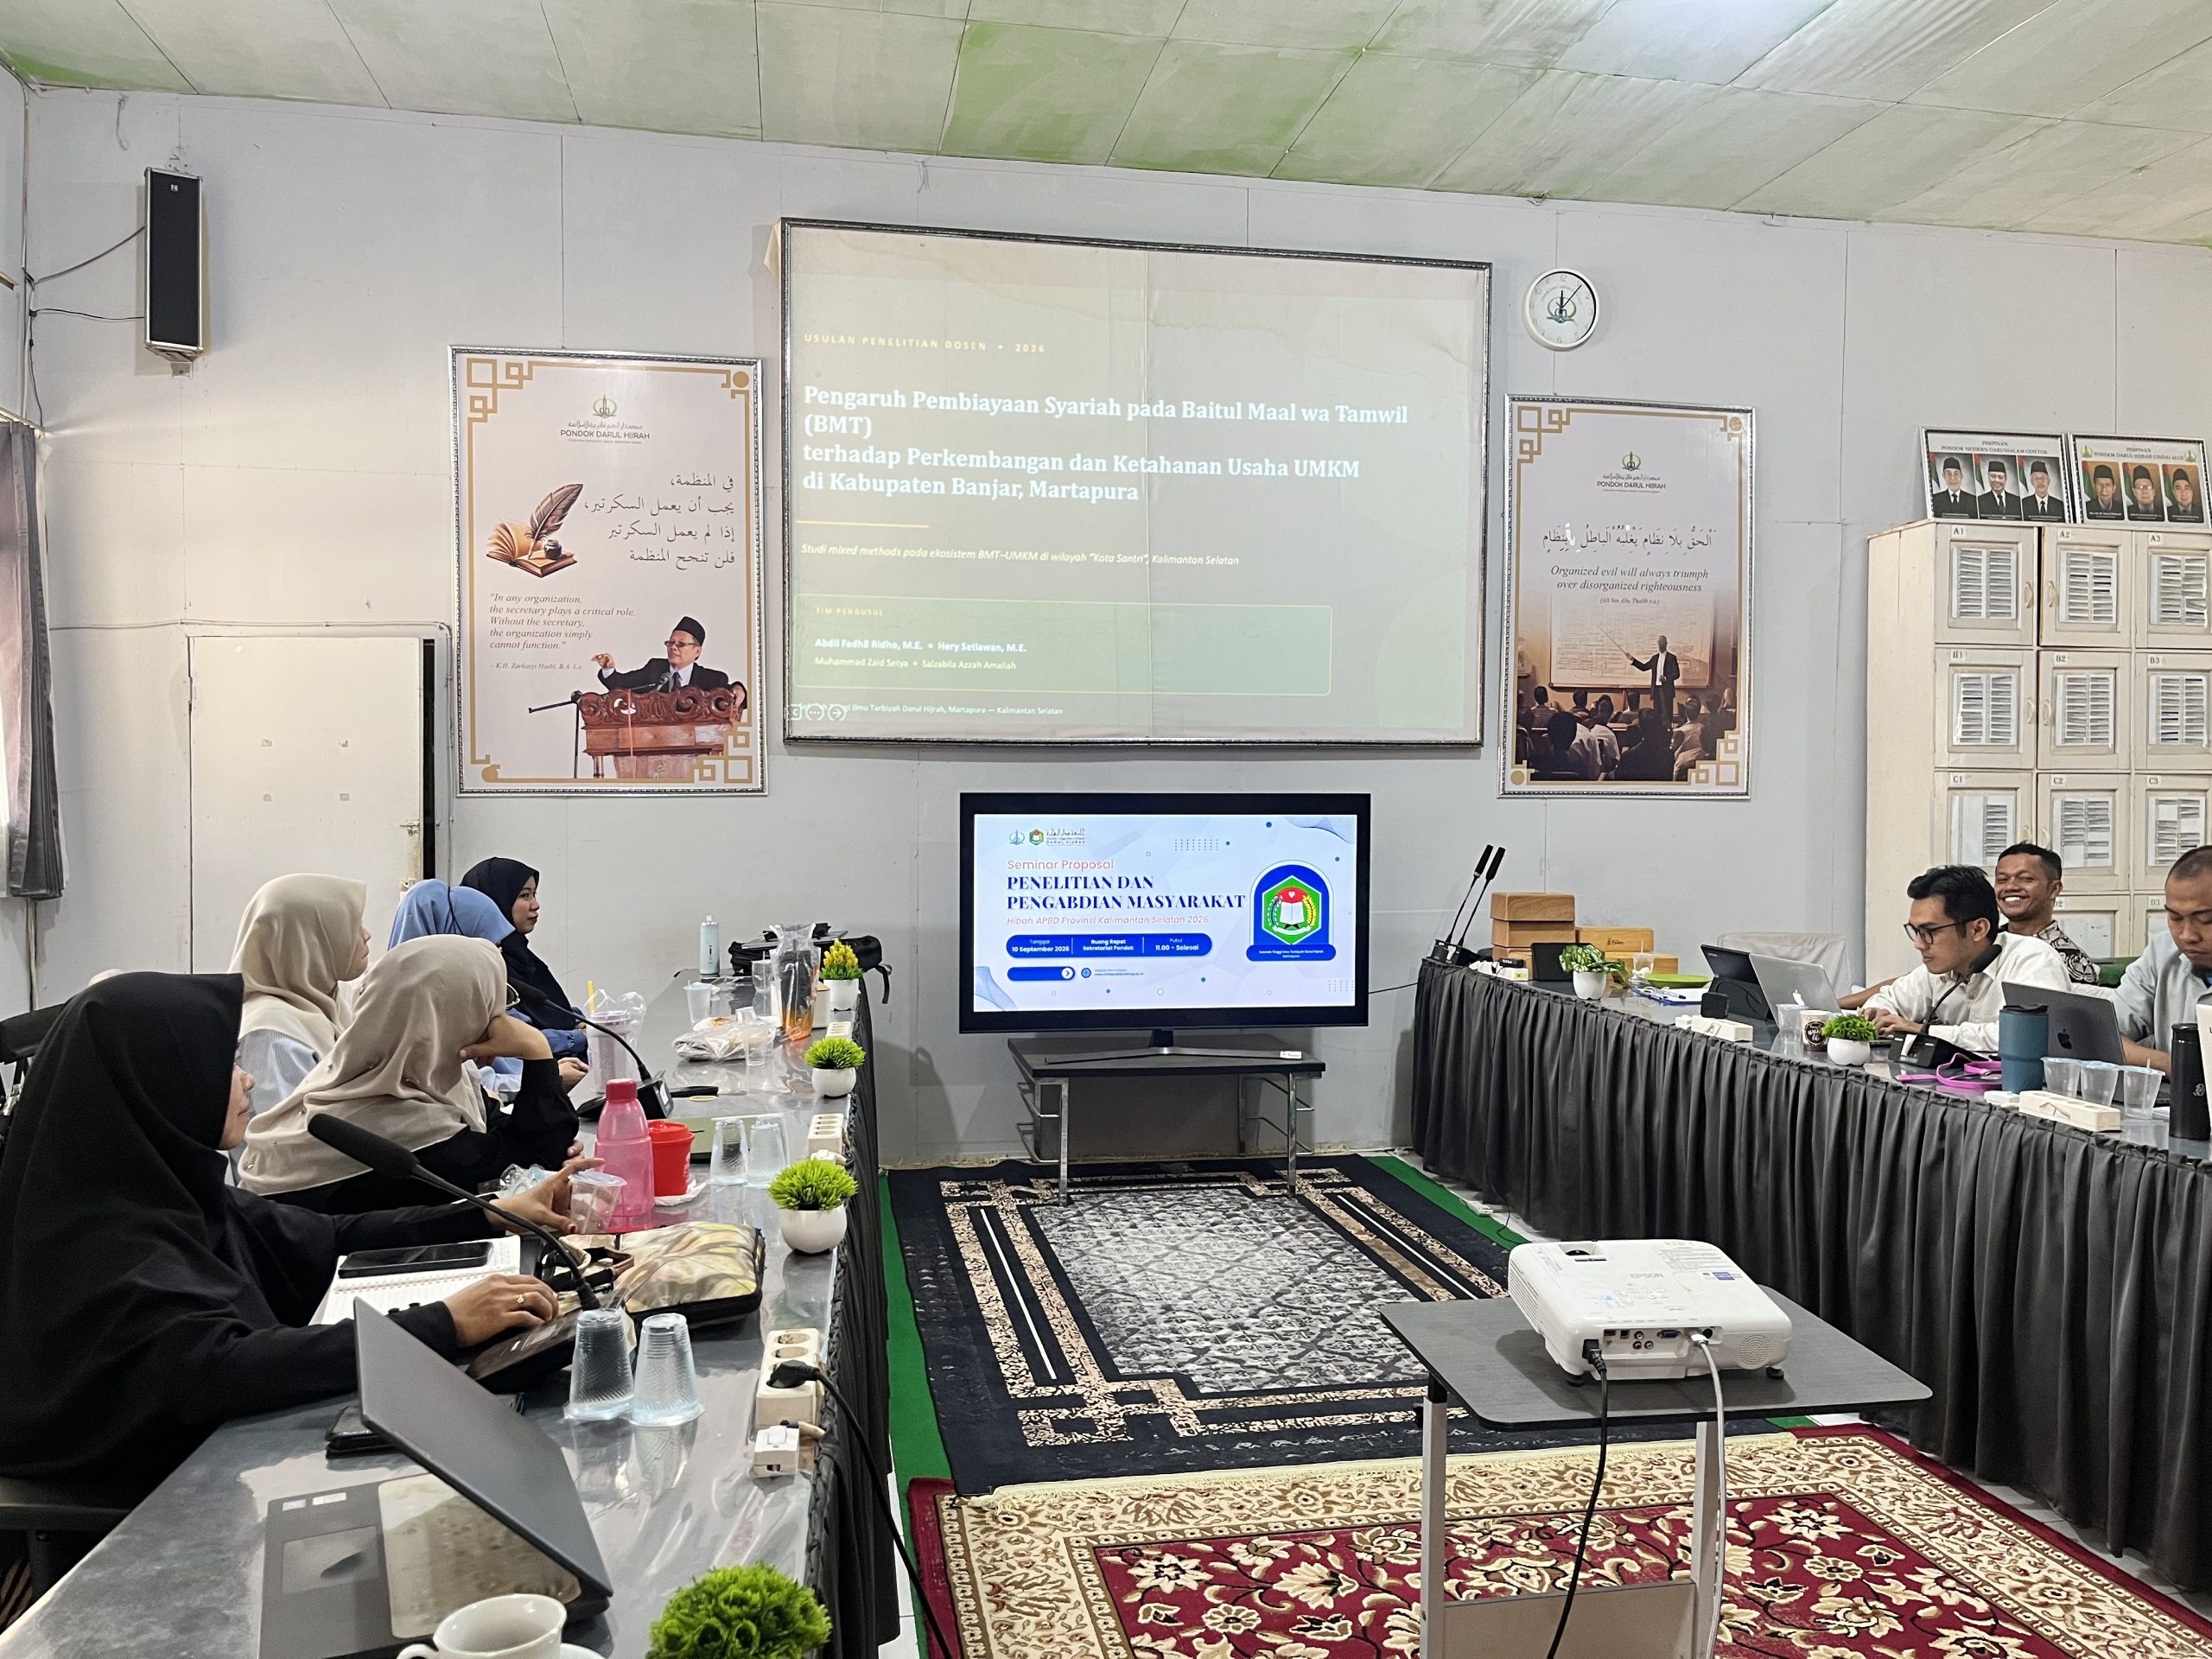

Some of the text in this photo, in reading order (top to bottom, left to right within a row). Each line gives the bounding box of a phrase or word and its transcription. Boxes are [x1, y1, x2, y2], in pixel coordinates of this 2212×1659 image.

[804, 334, 1045, 353] USULAN PENELITIAN DOSEN 2026
[804, 386, 1408, 423] Pengaruh Pembiayaan Syariah pada Baitul Maal wa Tamwil
[804, 415, 872, 438] (BMT)
[803, 444, 1359, 478] terhadap Perkembangan dan Ketahanan Usaha UMKM
[722, 475, 734, 493] في
[803, 472, 1138, 504] di Kabupaten Banjar, Martapura
[651, 498, 681, 516] يعمل
[688, 496, 701, 512] أن
[708, 502, 734, 516] يجب
[608, 519, 734, 544] إذا لم يعمل السكرتير
[630, 548, 734, 570] فلن تنجح المنظمة
[801, 543, 826, 554] Studi
[829, 544, 858, 555] mixed
[860, 545, 901, 556] methods
[903, 548, 927, 558] pada
[930, 549, 976, 559] ekosistem
[1039, 550, 1048, 561] di
[1051, 551, 1086, 563] wilayah
[1152, 555, 1203, 564] Kalimantan
[1205, 555, 1238, 565] Selatan
[1551, 565, 1708, 582] Organized evil will always triumph
[1557, 580, 1701, 594] over disorganized righteousness
[506, 595, 522, 604] any
[524, 594, 582, 605] organization,
[490, 605, 503, 613] the
[505, 607, 546, 616] secretary
[548, 607, 572, 617] plays
[582, 607, 613, 616] critical
[616, 607, 635, 616] role.
[490, 617, 584, 628] Without the secretary,
[490, 629, 593, 640] the organization simply
[490, 640, 520, 649] cannot
[903, 641, 924, 650] M.E.
[938, 641, 960, 652] Hery
[961, 642, 1004, 653] Setiawan,
[1006, 643, 1027, 652] M.E.
[815, 657, 866, 666] Muhammad
[868, 658, 885, 667] Zaid
[948, 706, 986, 715] Martapura
[996, 707, 1036, 715] Kalimantan
[1007, 860, 1113, 872] Seminar Proposal
[1007, 876, 1154, 889] PENELITIAN DAN
[1007, 895, 1245, 909] PENGABDIAN MASYARAKAT
[1062, 916, 1096, 925] Provinsi
